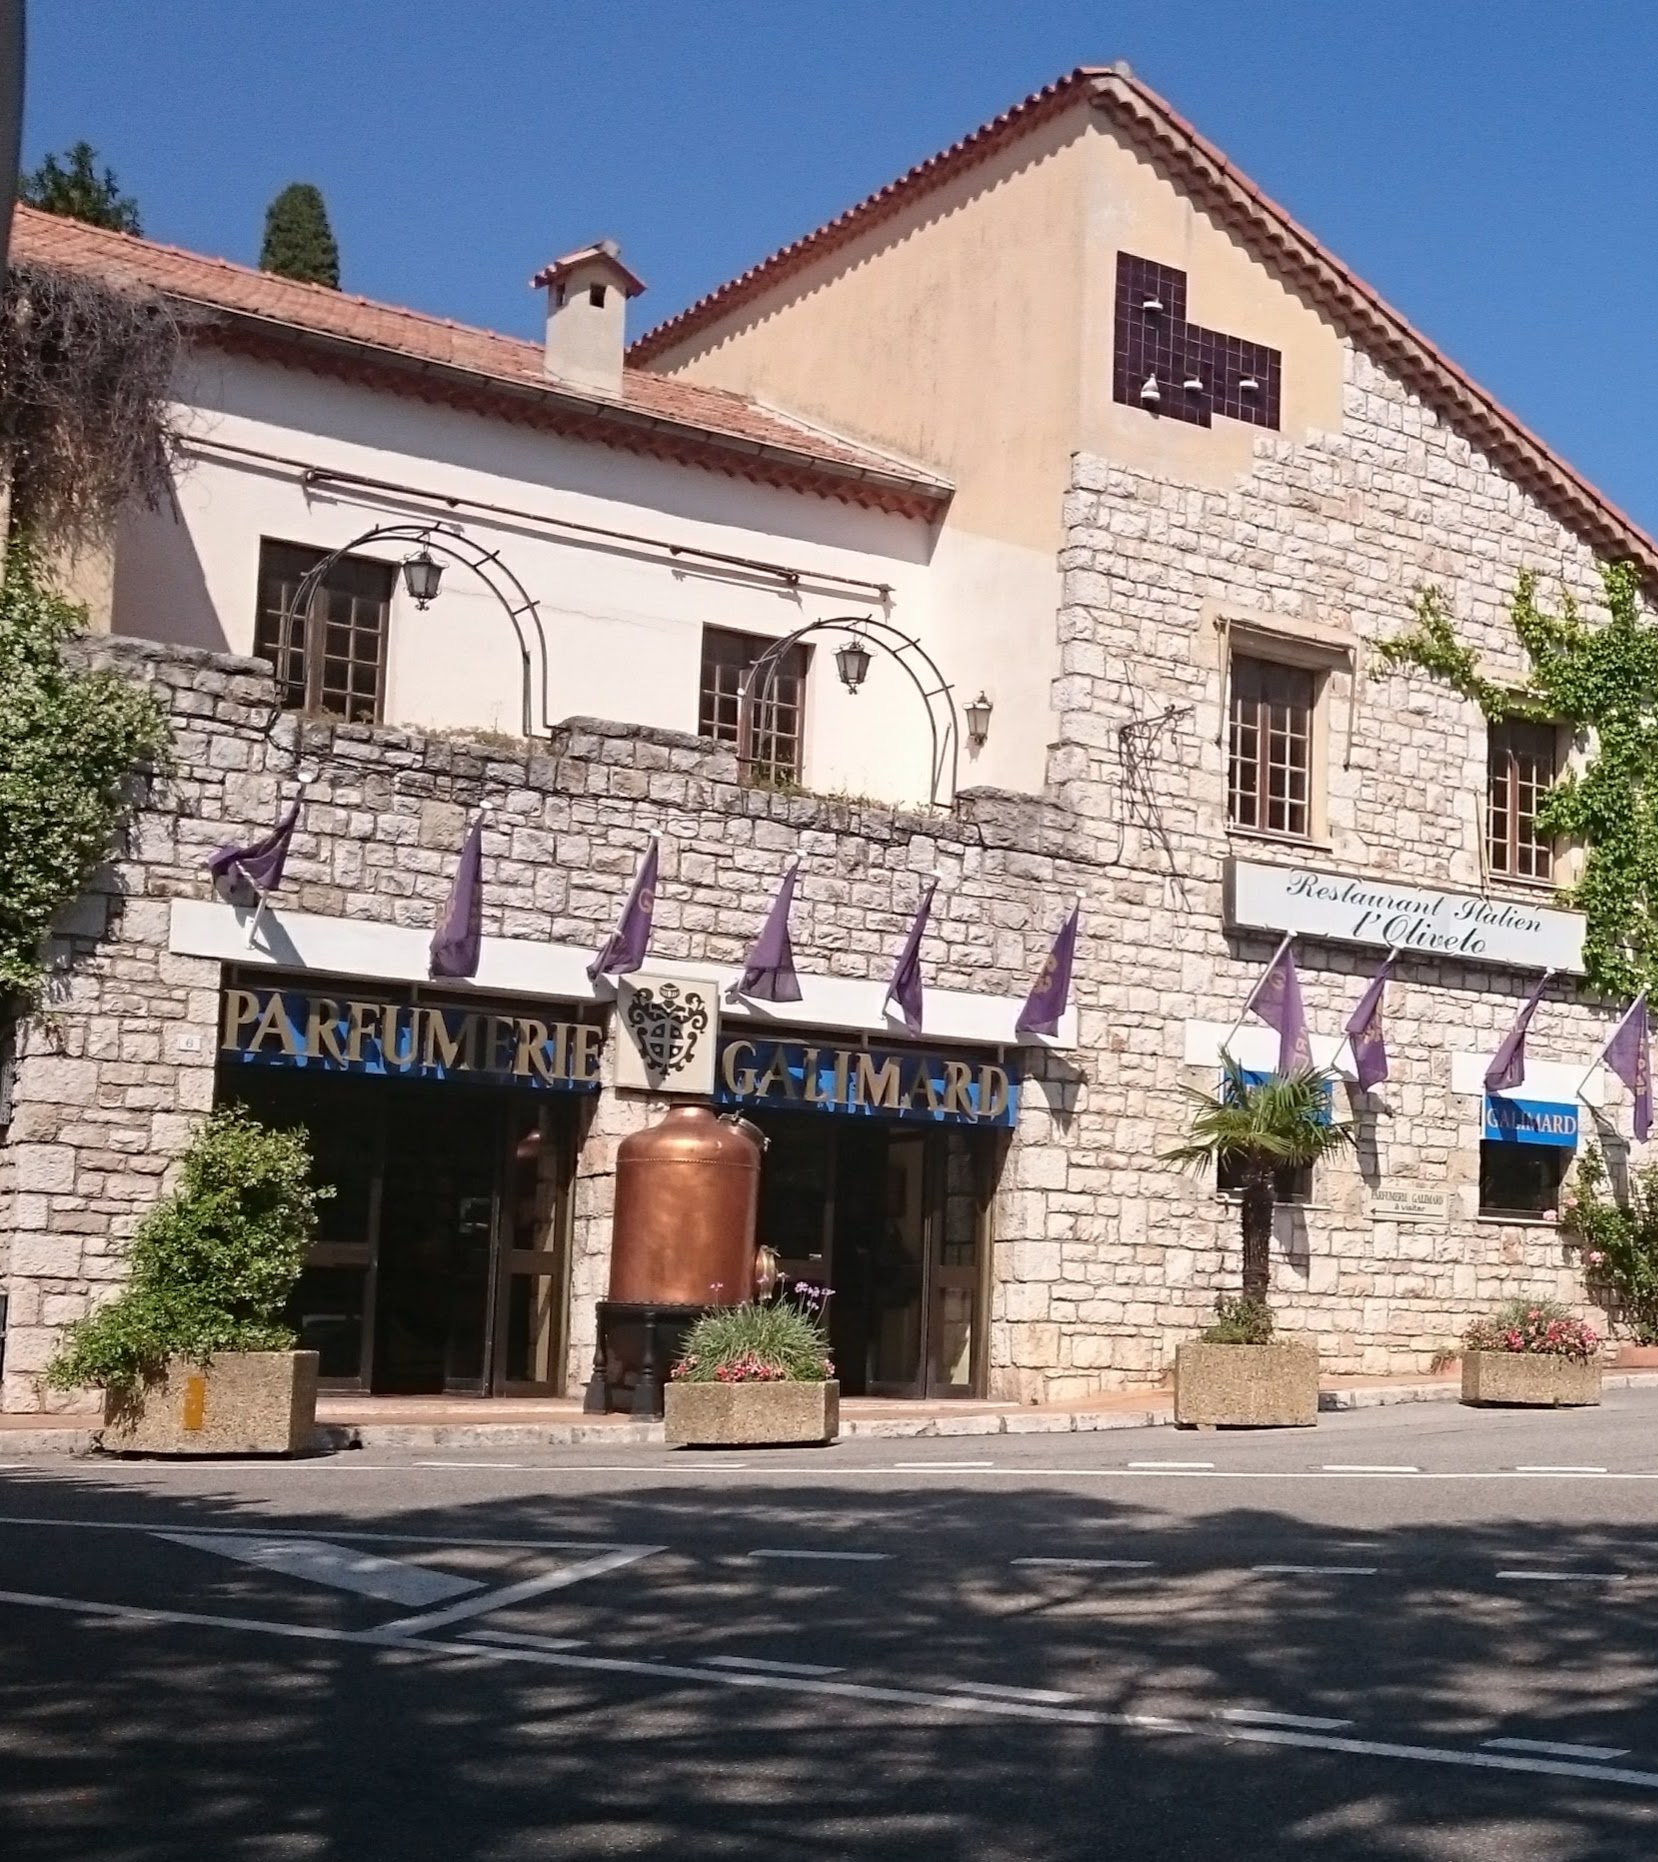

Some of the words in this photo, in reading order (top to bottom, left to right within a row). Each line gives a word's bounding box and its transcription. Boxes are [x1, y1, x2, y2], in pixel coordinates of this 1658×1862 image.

[1286, 872, 1445, 916] Restaurant
[1454, 898, 1543, 933] Italien
[1352, 911, 1487, 955] l'Oliveto
[221, 988, 602, 1087] PARFUMERIE
[722, 1040, 1009, 1121] GALIMARD
[1486, 1107, 1577, 1135] GALIMARD
